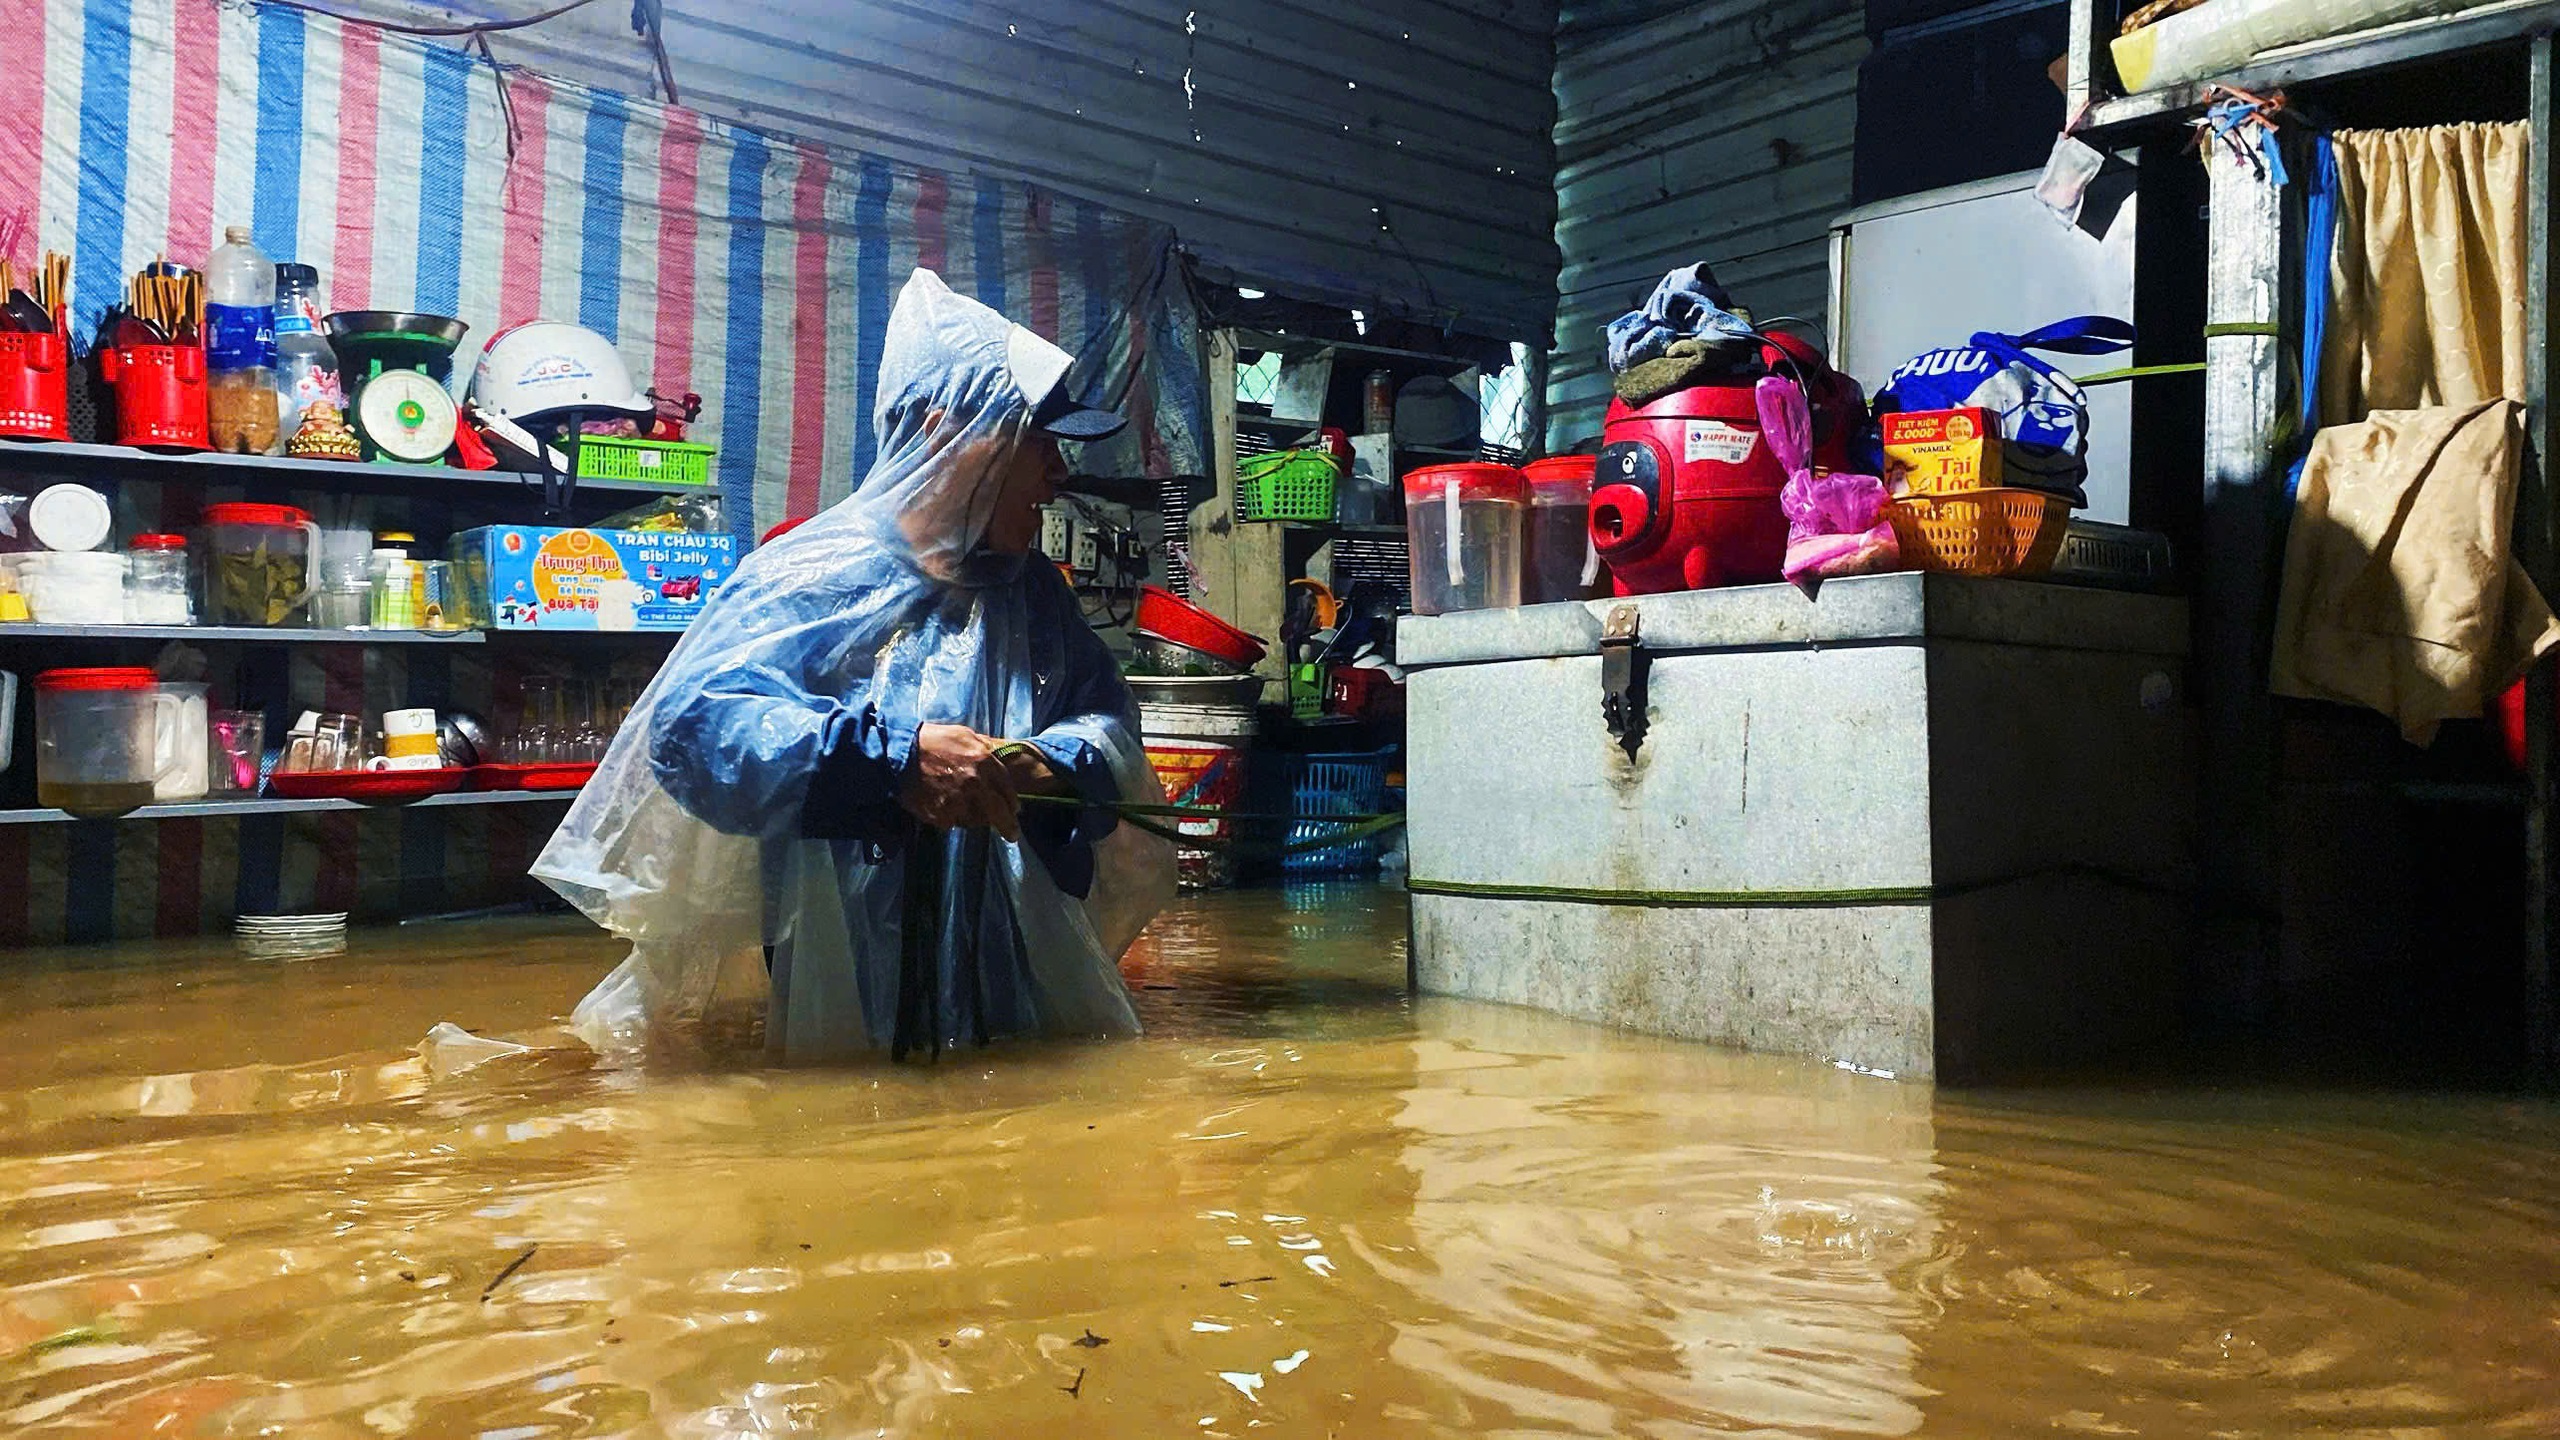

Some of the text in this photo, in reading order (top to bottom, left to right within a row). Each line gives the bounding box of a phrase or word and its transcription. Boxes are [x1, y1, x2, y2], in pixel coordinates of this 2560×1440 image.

[538, 364, 571, 376] JVC
[1703, 433, 1751, 444] HAPPY MATE
[1913, 445, 1952, 454] VINAMILK
[1938, 456, 1971, 475] Tài
[710, 536, 731, 551] 3Q
[539, 555, 619, 573] Trung Thu
[639, 548, 709, 566] Bibi Jelly
